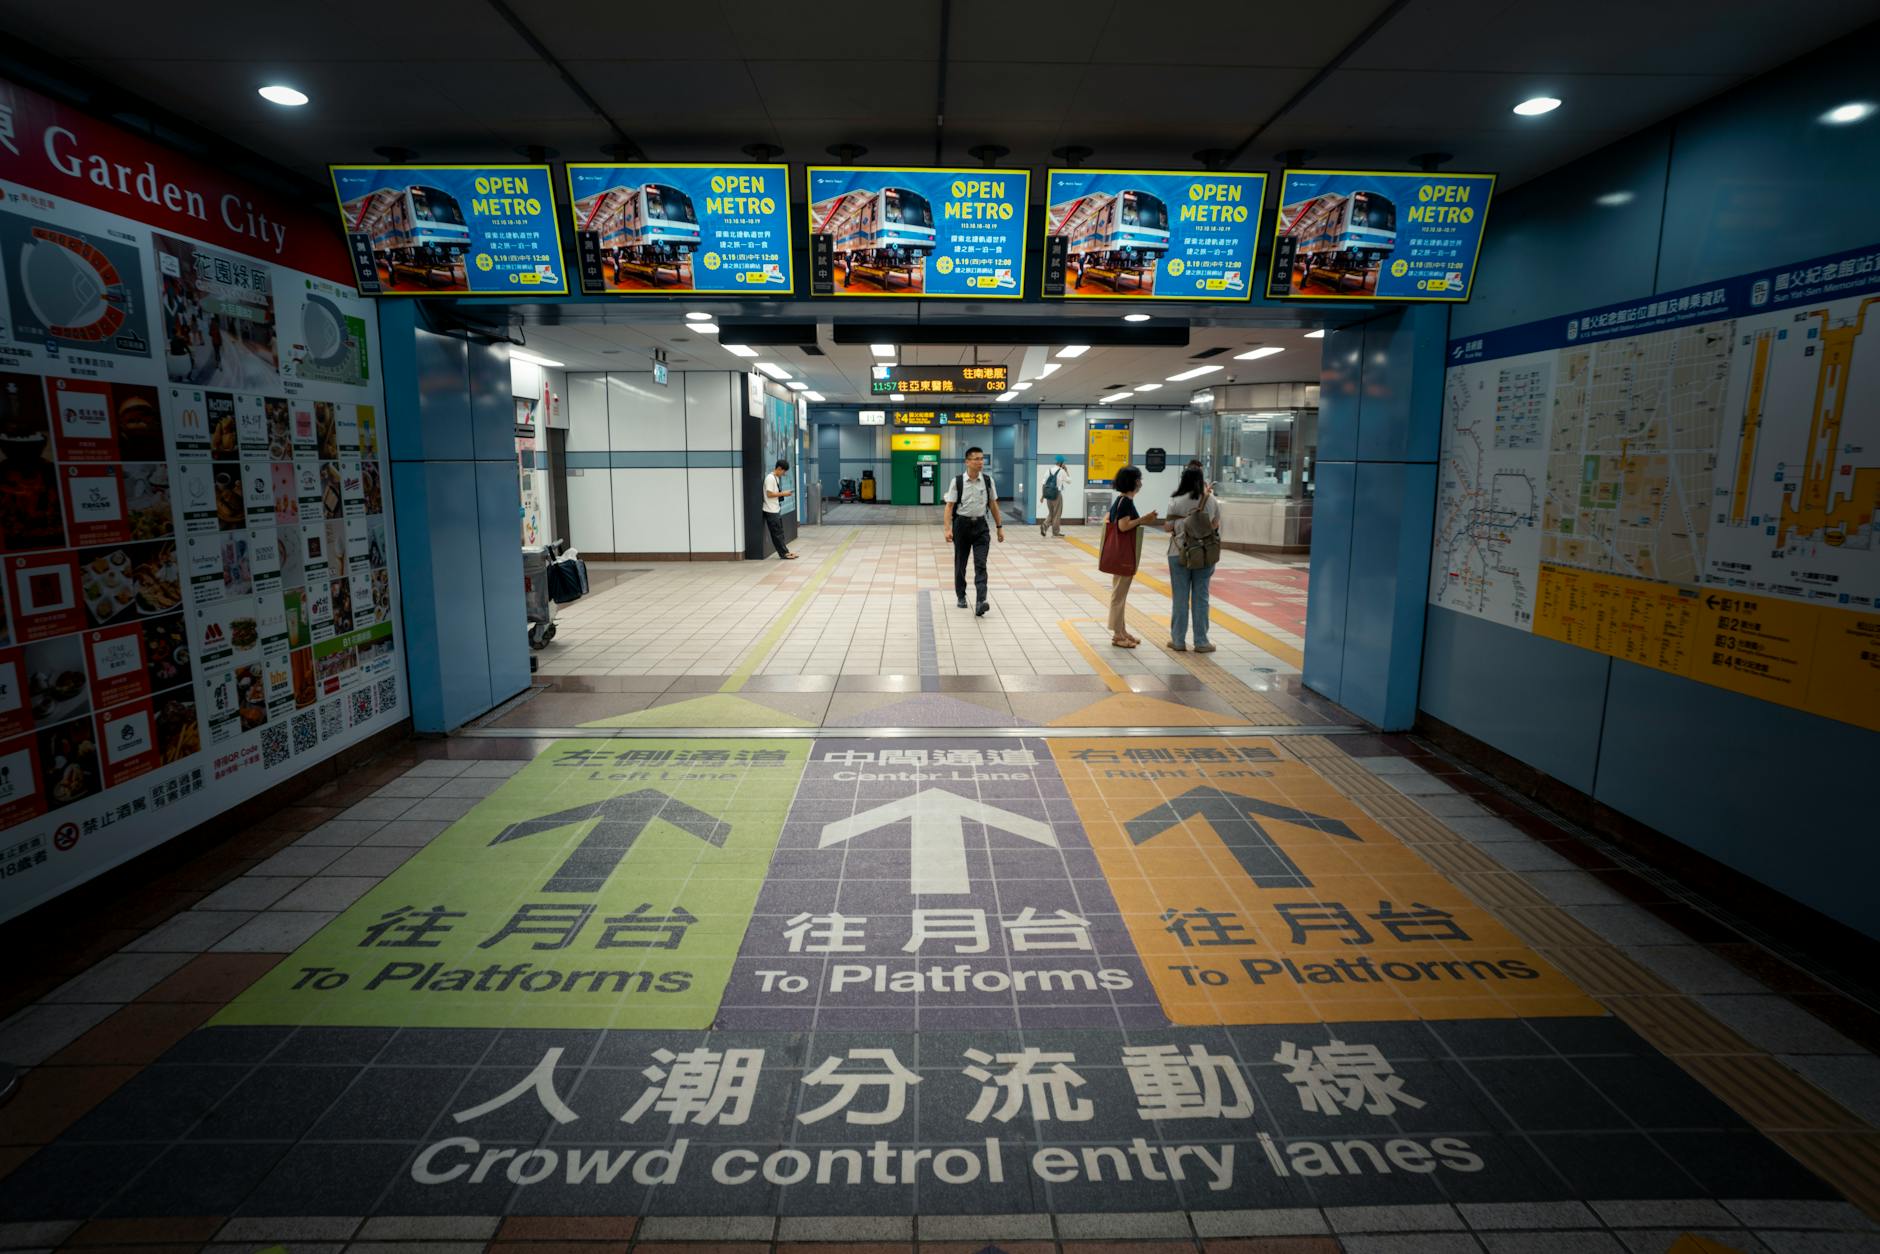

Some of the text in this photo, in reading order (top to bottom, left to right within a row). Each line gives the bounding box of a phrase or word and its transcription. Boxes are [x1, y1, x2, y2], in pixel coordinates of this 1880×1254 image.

[43, 125, 208, 222] Garden
[219, 192, 288, 255] City
[475, 177, 529, 195] OPEN
[711, 176, 764, 194] OPEN
[951, 181, 1005, 199] OPEN
[1189, 184, 1242, 202] OPEN
[1418, 185, 1470, 203] OPEN
[472, 198, 541, 216] METRO
[706, 197, 775, 215] METRO
[944, 202, 1013, 220] METRO
[1180, 205, 1248, 223] METRO
[1407, 206, 1474, 224] METRO
[192, 252, 267, 293] 花園綠廊
[962, 368, 1006, 379] 往南港展
[873, 380, 1006, 392] 11:57 往亞東醫院 0:30
[901, 413, 908, 423] 4
[975, 413, 983, 424] 3
[552, 749, 790, 767] 左側通道
[823, 748, 1040, 767] 中間通道
[1069, 747, 1284, 764] 右側通道
[588, 771, 737, 781] Left Lane
[833, 771, 1029, 781] Center Lane
[1105, 768, 1274, 780] Right Lane
[83, 796, 146, 836] 禁止酒駕
[289, 961, 695, 993] To Platforms
[755, 964, 1134, 993] To Platforms
[1167, 957, 1541, 987] To Platforms
[452, 1039, 1428, 1126] 人潮分流動線
[410, 1132, 1486, 1191] Crowd control entry lanes
